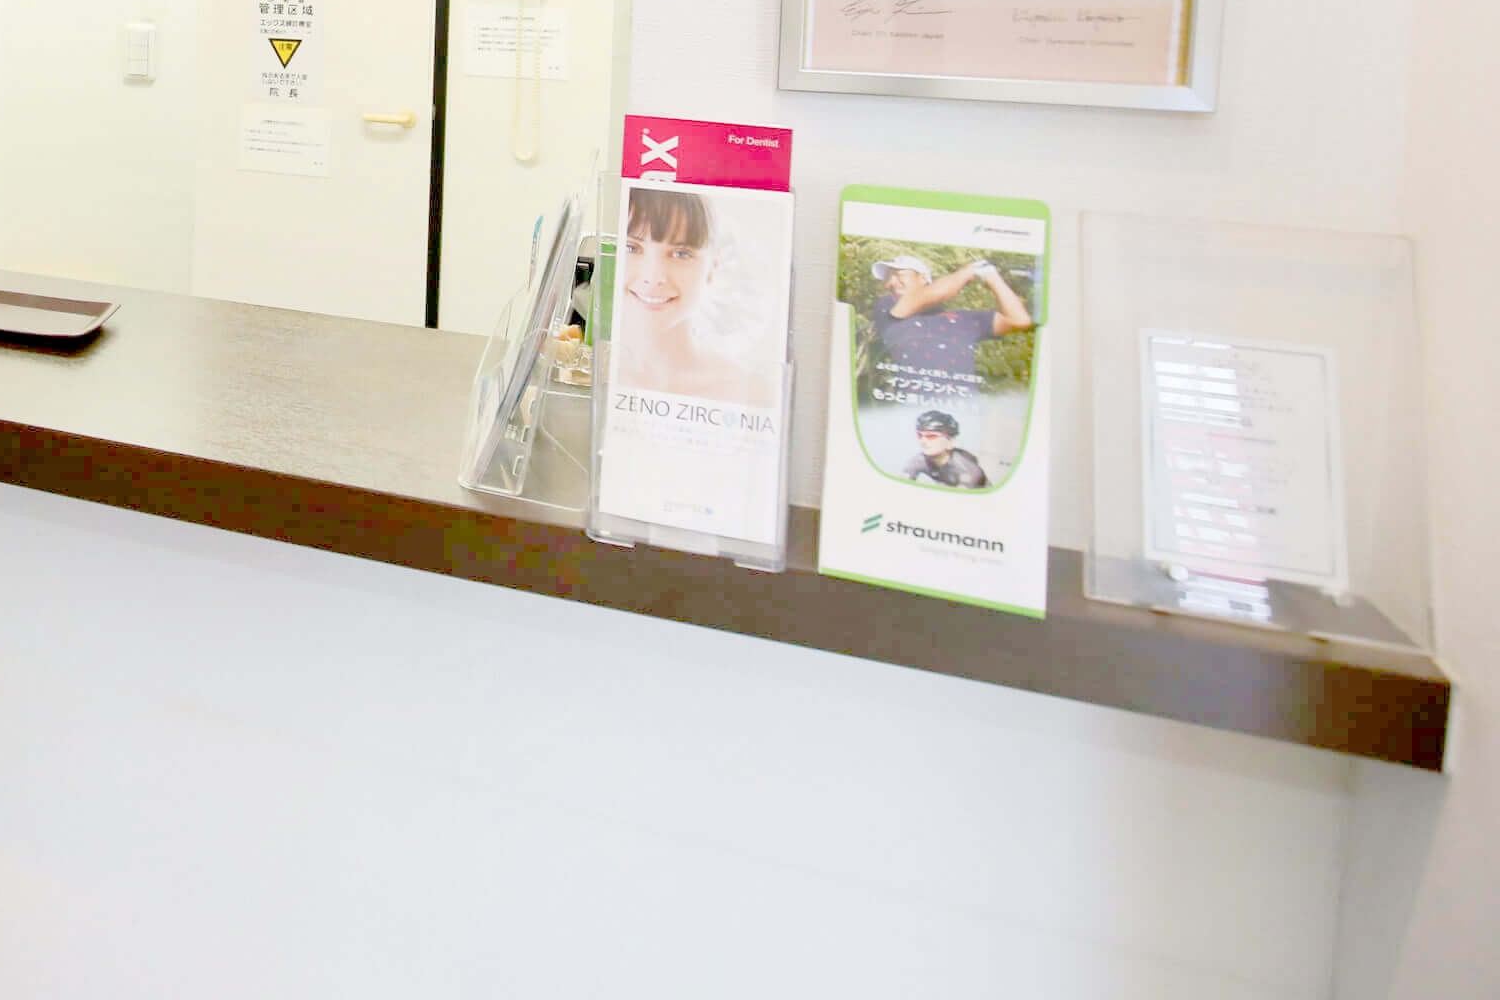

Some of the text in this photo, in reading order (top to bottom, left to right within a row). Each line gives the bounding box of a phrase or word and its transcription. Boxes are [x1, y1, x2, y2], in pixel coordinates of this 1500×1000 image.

[259, 2, 314, 16] 管理区域
[728, 134, 779, 149] For Dentist
[614, 393, 671, 417] ZENO
[885, 520, 1005, 554] straumann
